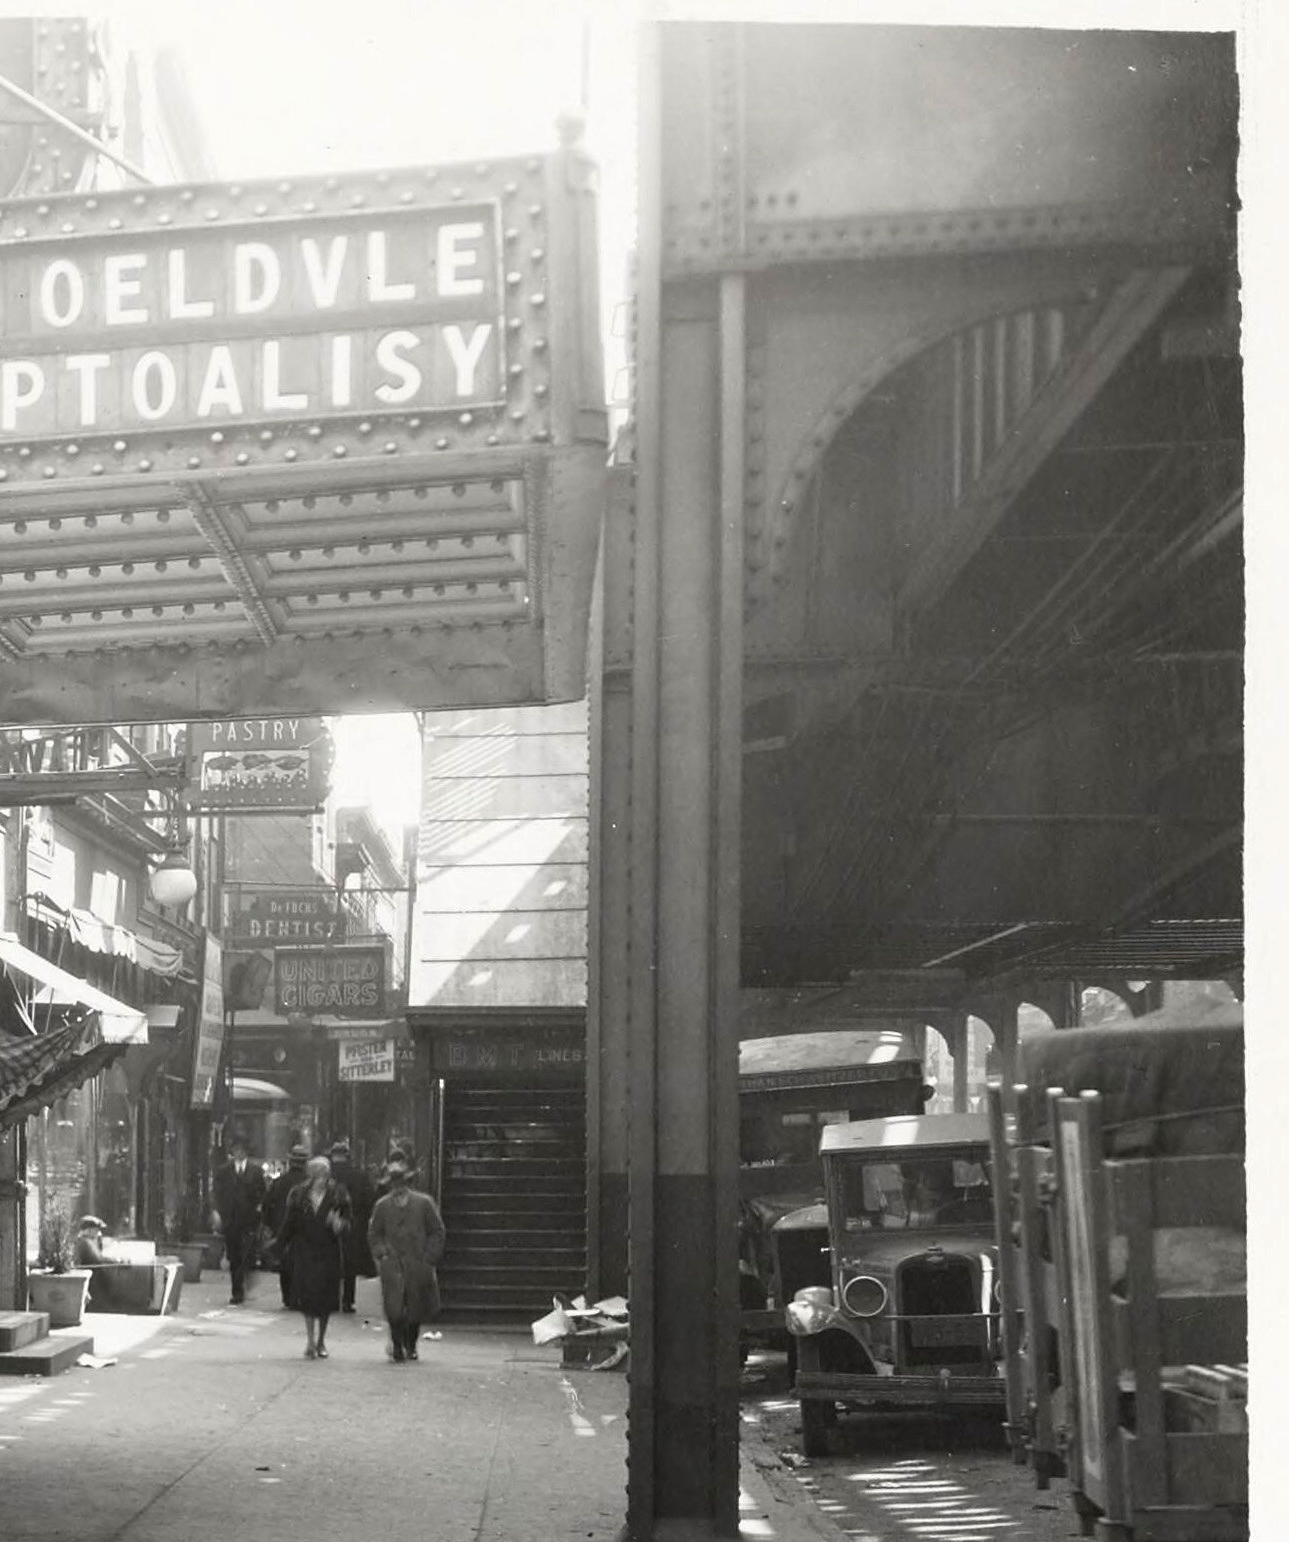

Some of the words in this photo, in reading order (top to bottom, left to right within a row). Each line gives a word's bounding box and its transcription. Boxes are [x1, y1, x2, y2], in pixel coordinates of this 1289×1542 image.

[40, 222, 486, 328] OELDVLE
[212, 720, 300, 742] PASTRY
[249, 919, 337, 938] DENTIST
[280, 960, 379, 982] UNITED
[280, 982, 379, 1007] CIGARS
